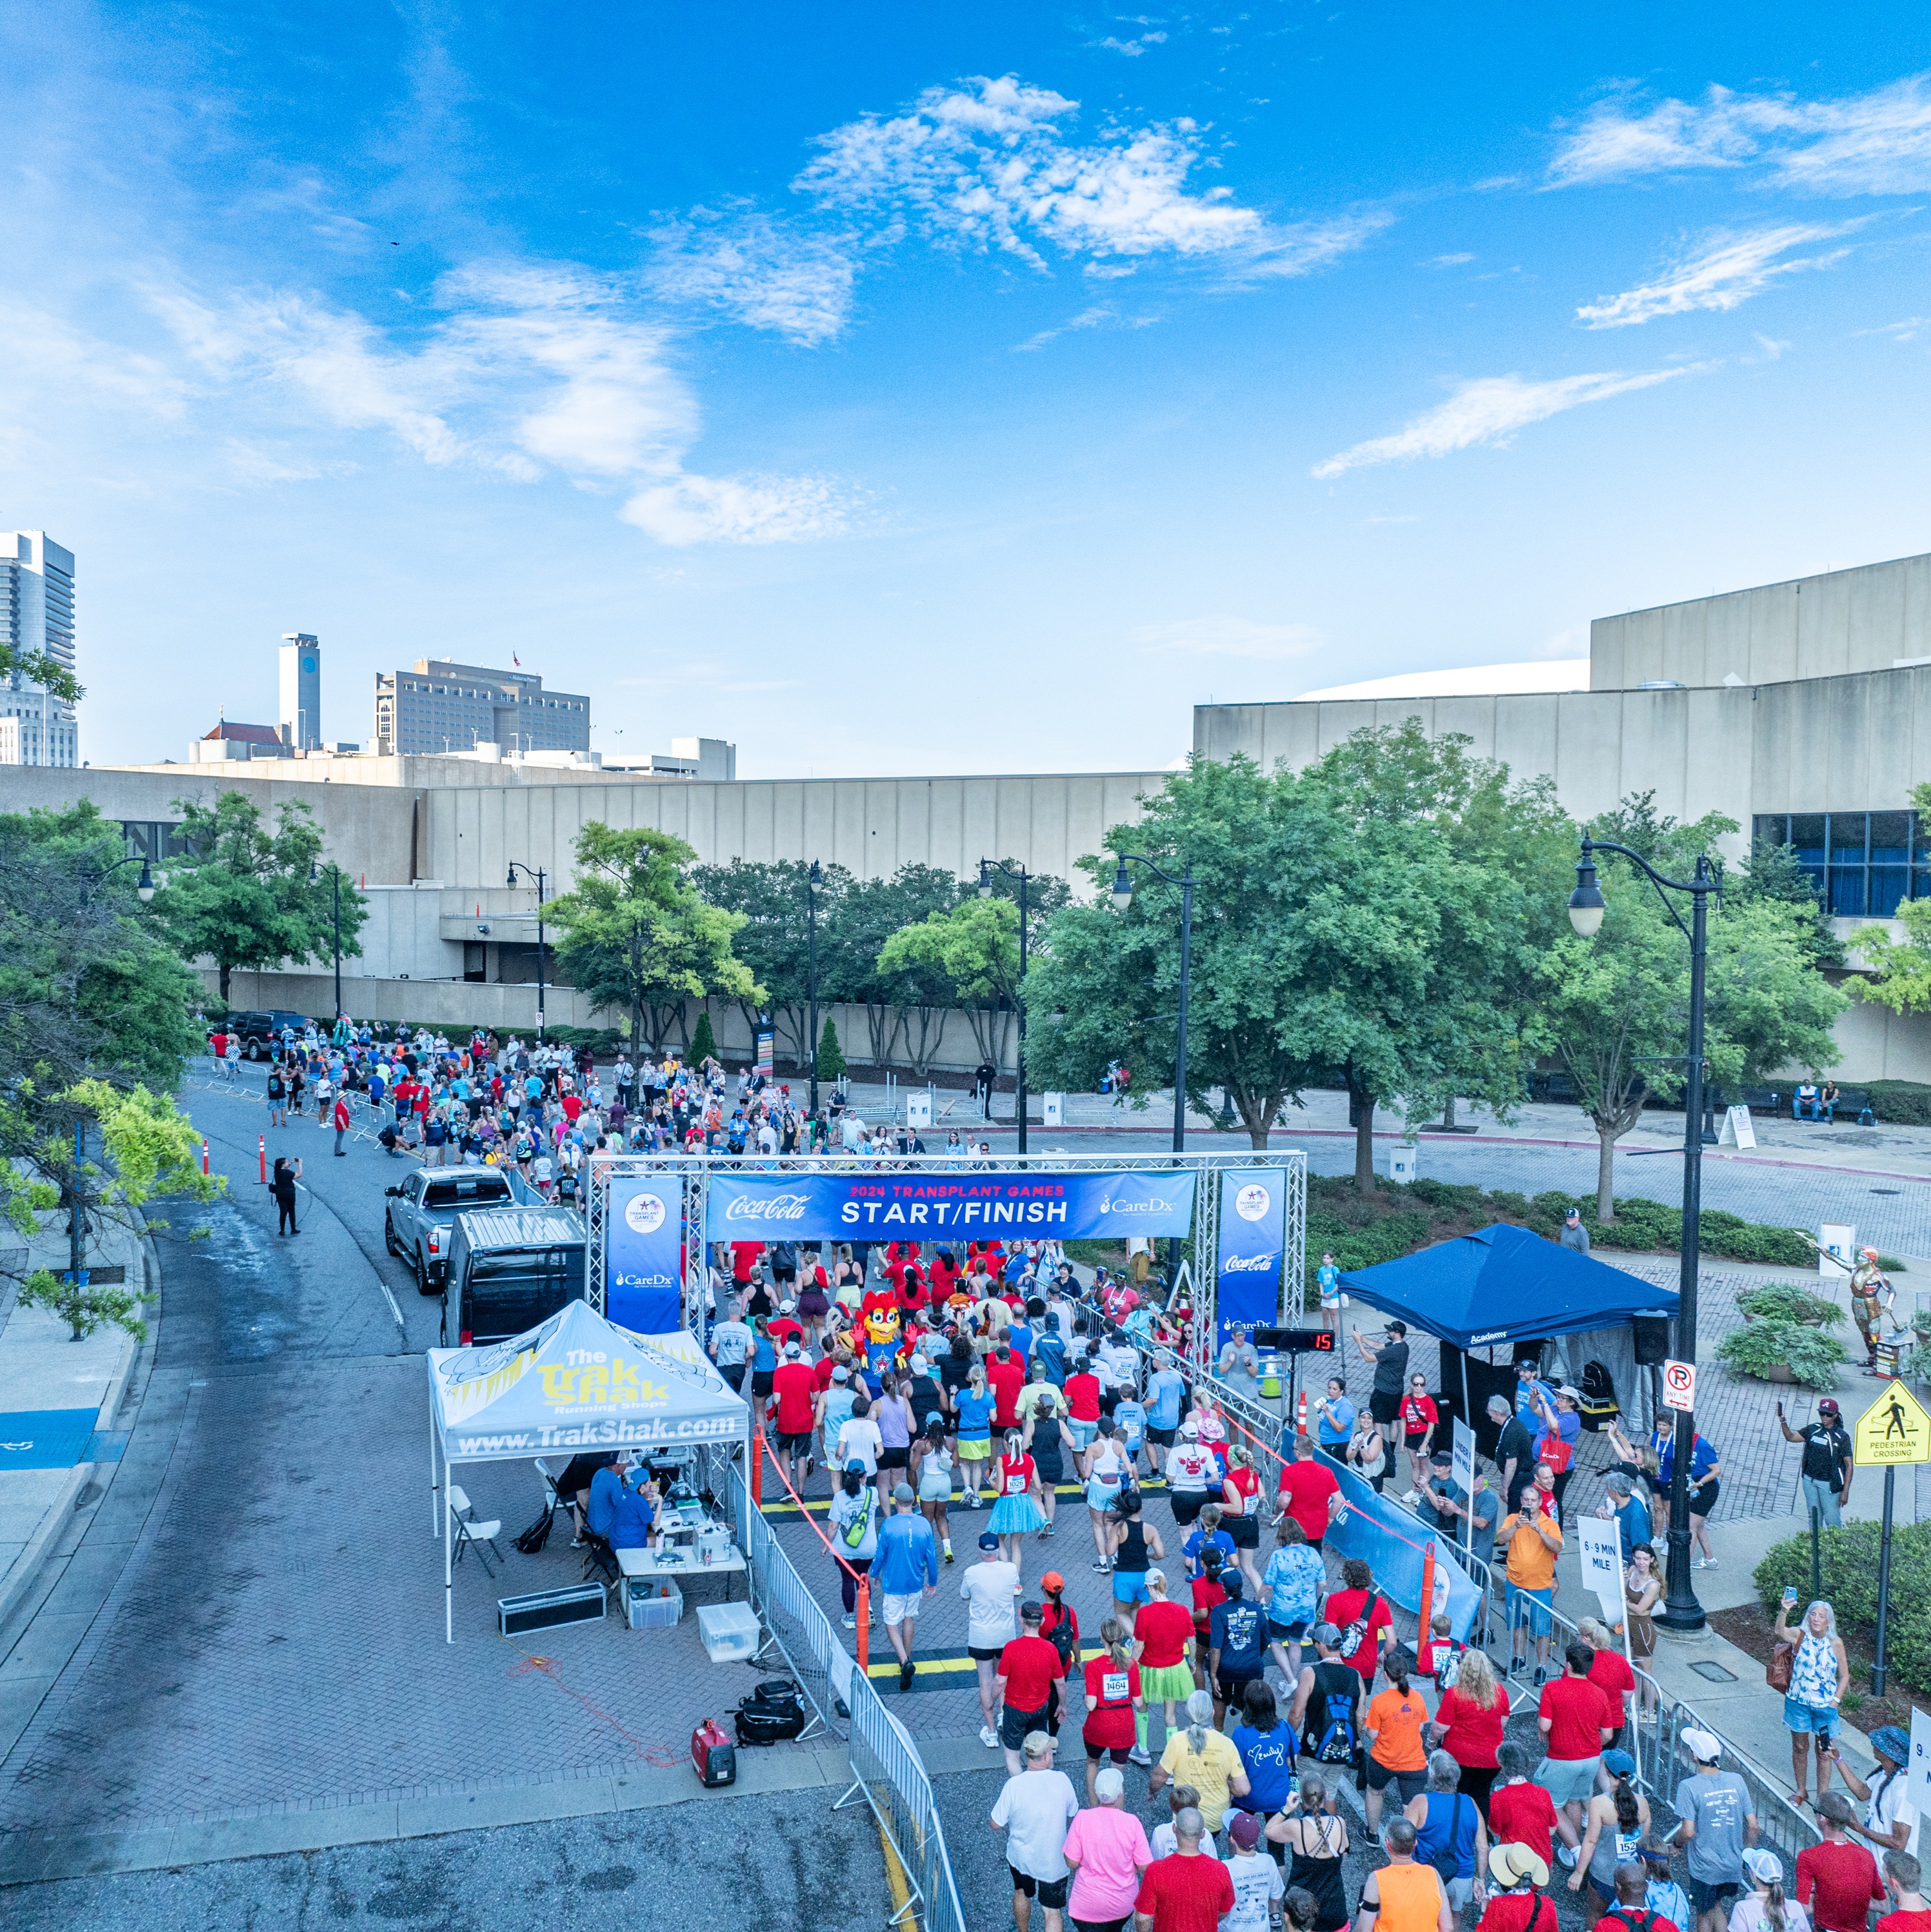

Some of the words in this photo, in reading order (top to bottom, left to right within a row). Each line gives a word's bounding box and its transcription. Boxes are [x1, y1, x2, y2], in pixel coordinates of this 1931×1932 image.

[850, 1186, 885, 1197] 2024
[892, 1185, 1002, 1198] TRANSPLANT
[1007, 1185, 1064, 1197] GAMES
[726, 1195, 812, 1220] Coca-Cola
[1112, 1198, 1174, 1212] CareDx
[841, 1201, 1067, 1225] START/FINISH
[1226, 1255, 1275, 1272] Coca-Cola
[625, 1275, 672, 1285] CareDx
[1316, 1333, 1331, 1349] 15
[1470, 1331, 1508, 1343] Academy
[566, 1349, 608, 1366] The
[537, 1359, 641, 1391] Trak
[554, 1402, 617, 1415] Running
[621, 1400, 668, 1409] Shops
[458, 1417, 735, 1455] www.TrakShak.com
[1455, 1439, 1468, 1458] UNDER
[1870, 1440, 1917, 1449] PEDESTRIAN
[1874, 1449, 1912, 1458] CROSSING
[1601, 1544, 1616, 1557] MIN
[1592, 1557, 1610, 1571] MILE
[1436, 1653, 1449, 1662] 212
[1106, 1681, 1126, 1690] 1464
[1619, 1842, 1636, 1852] 152
